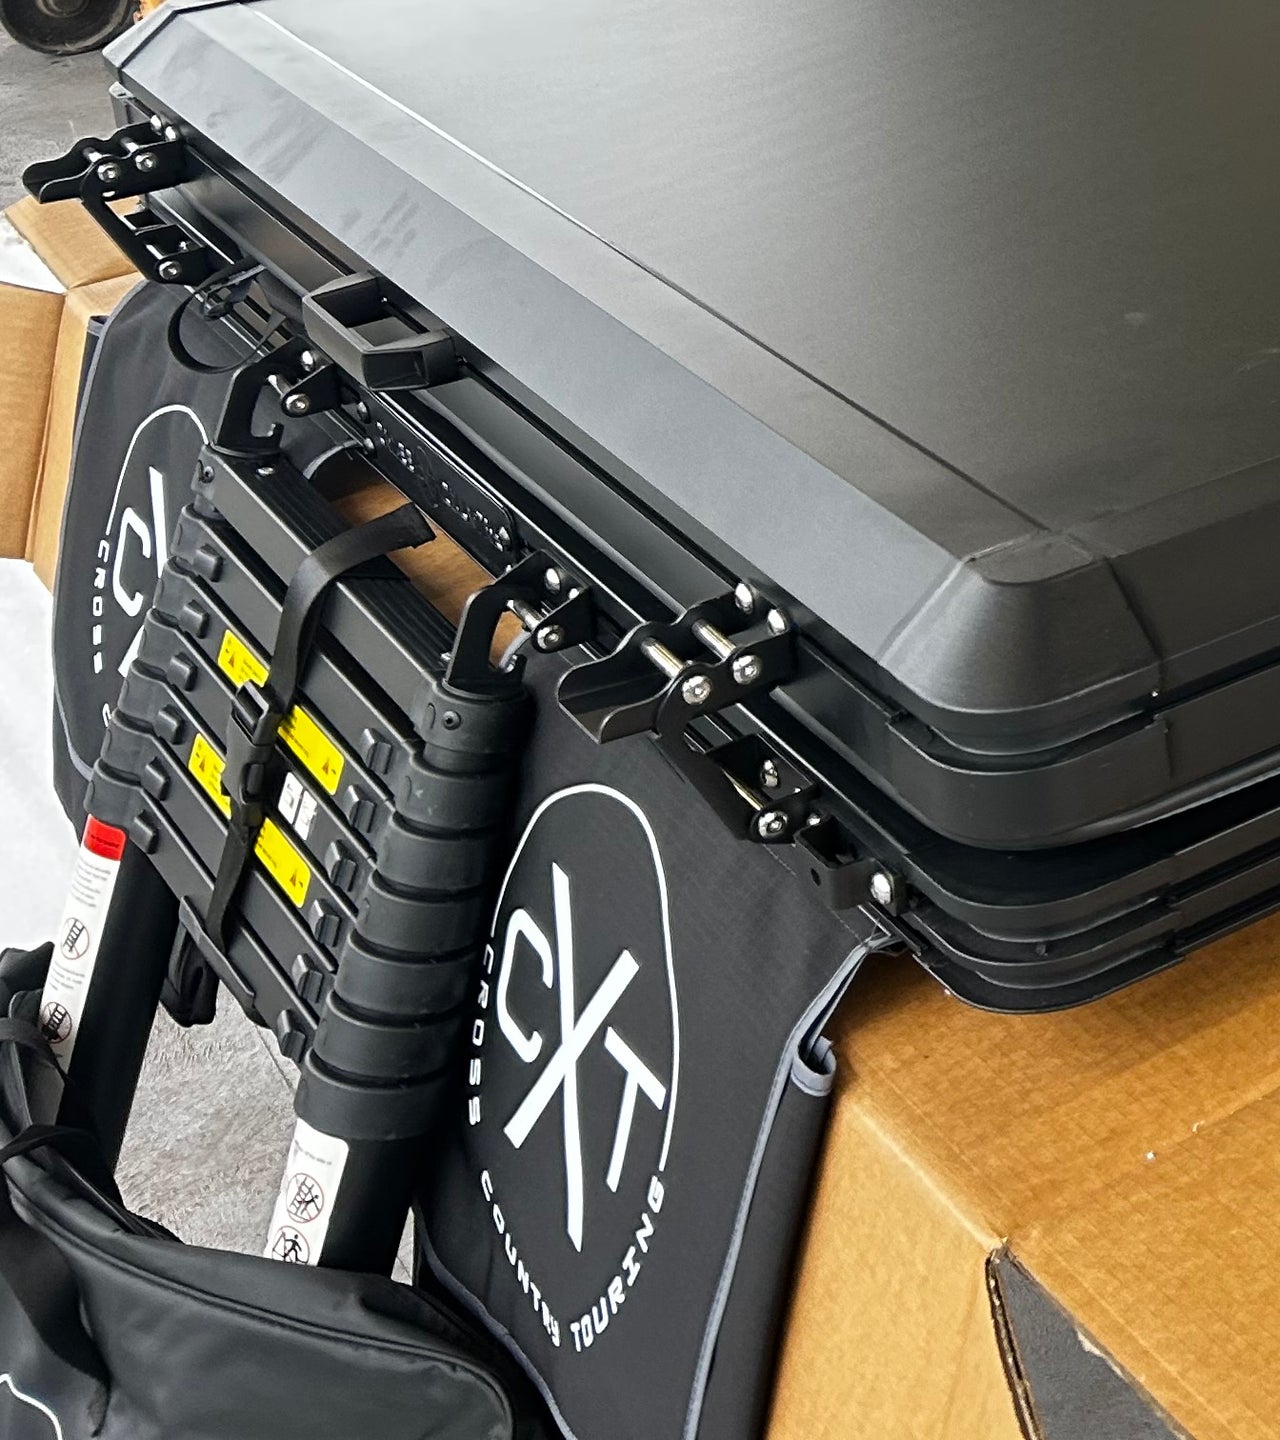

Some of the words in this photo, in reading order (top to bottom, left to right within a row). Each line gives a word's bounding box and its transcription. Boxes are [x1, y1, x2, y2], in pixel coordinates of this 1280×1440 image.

[467, 942, 495, 1127] CROSS
[480, 1169, 562, 1348] COUNTRY
[569, 1174, 666, 1353] TOURING
